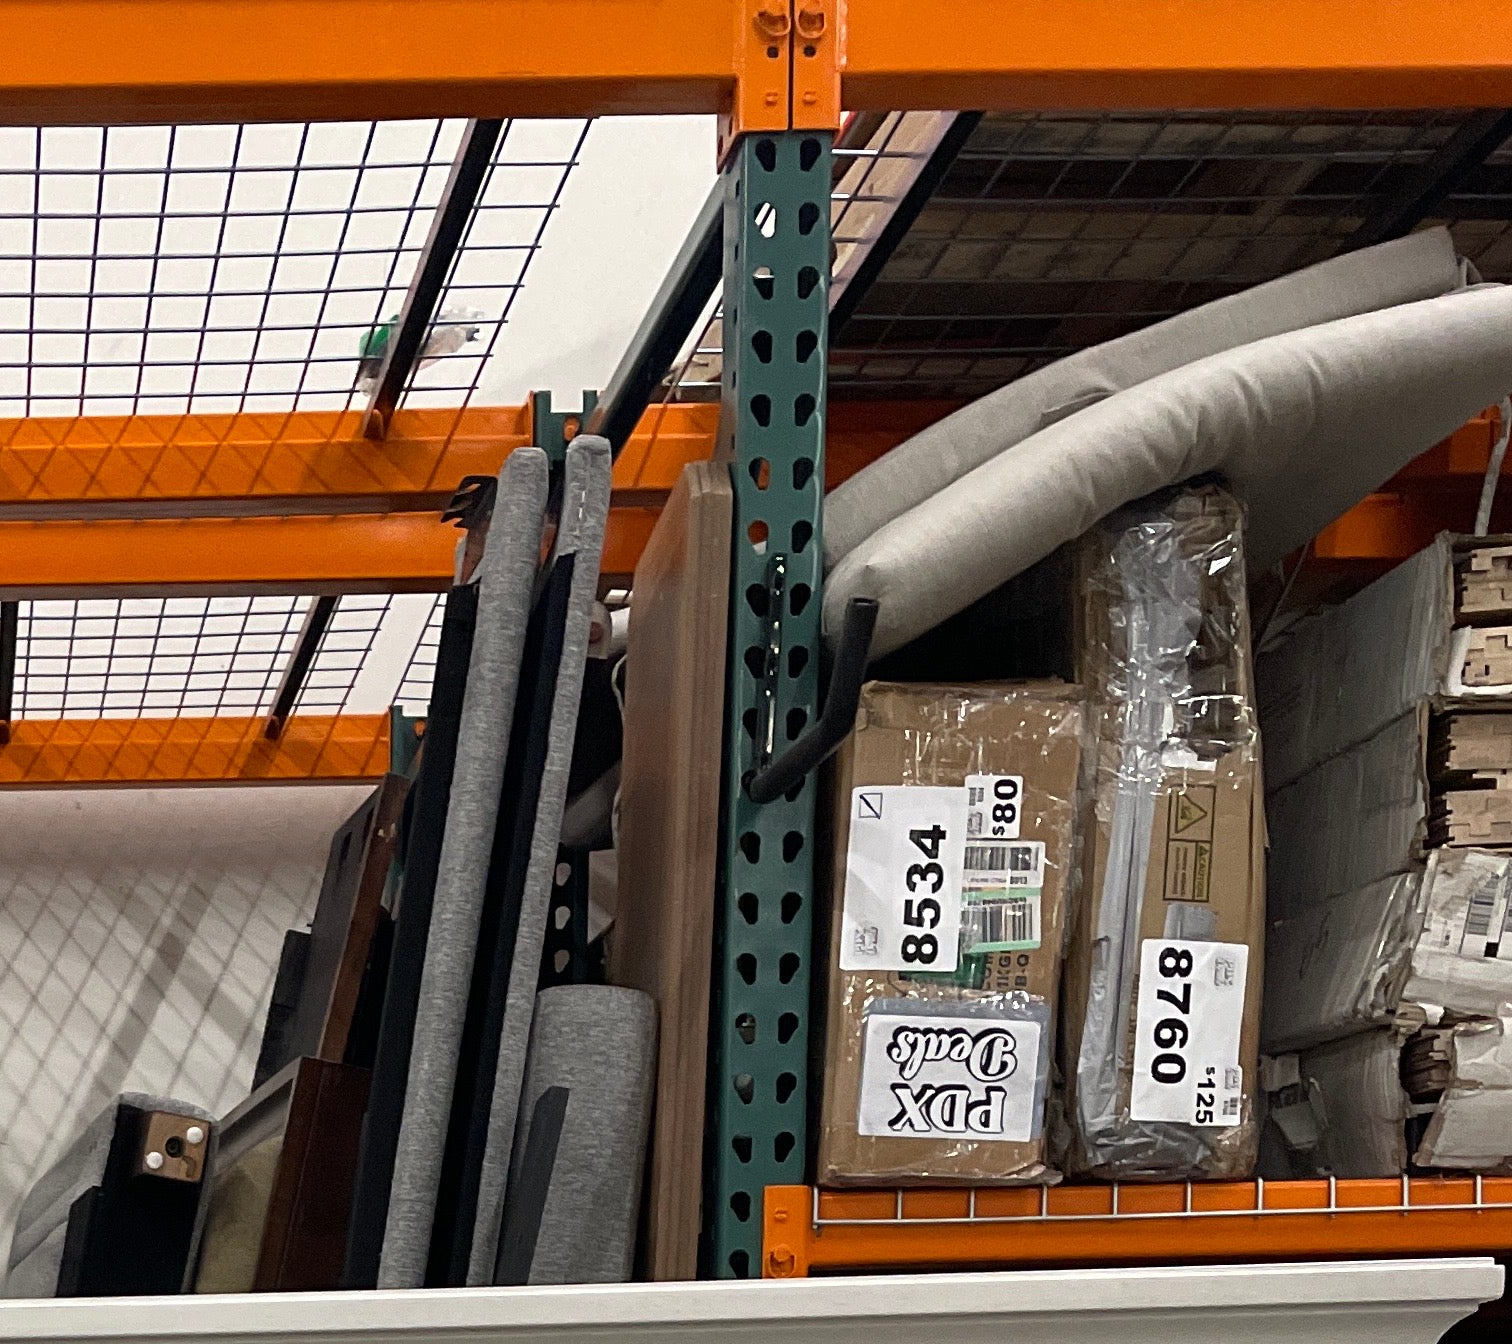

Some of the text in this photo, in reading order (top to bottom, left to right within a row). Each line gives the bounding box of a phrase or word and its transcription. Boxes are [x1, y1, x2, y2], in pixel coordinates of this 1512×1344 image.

[992, 779, 1018, 836] $80
[901, 825, 947, 965] 8534
[1151, 947, 1193, 1085] 8760
[886, 1025, 1017, 1083] Deals
[888, 1082, 1007, 1135] PDX
[1195, 1066, 1216, 1125] $125
